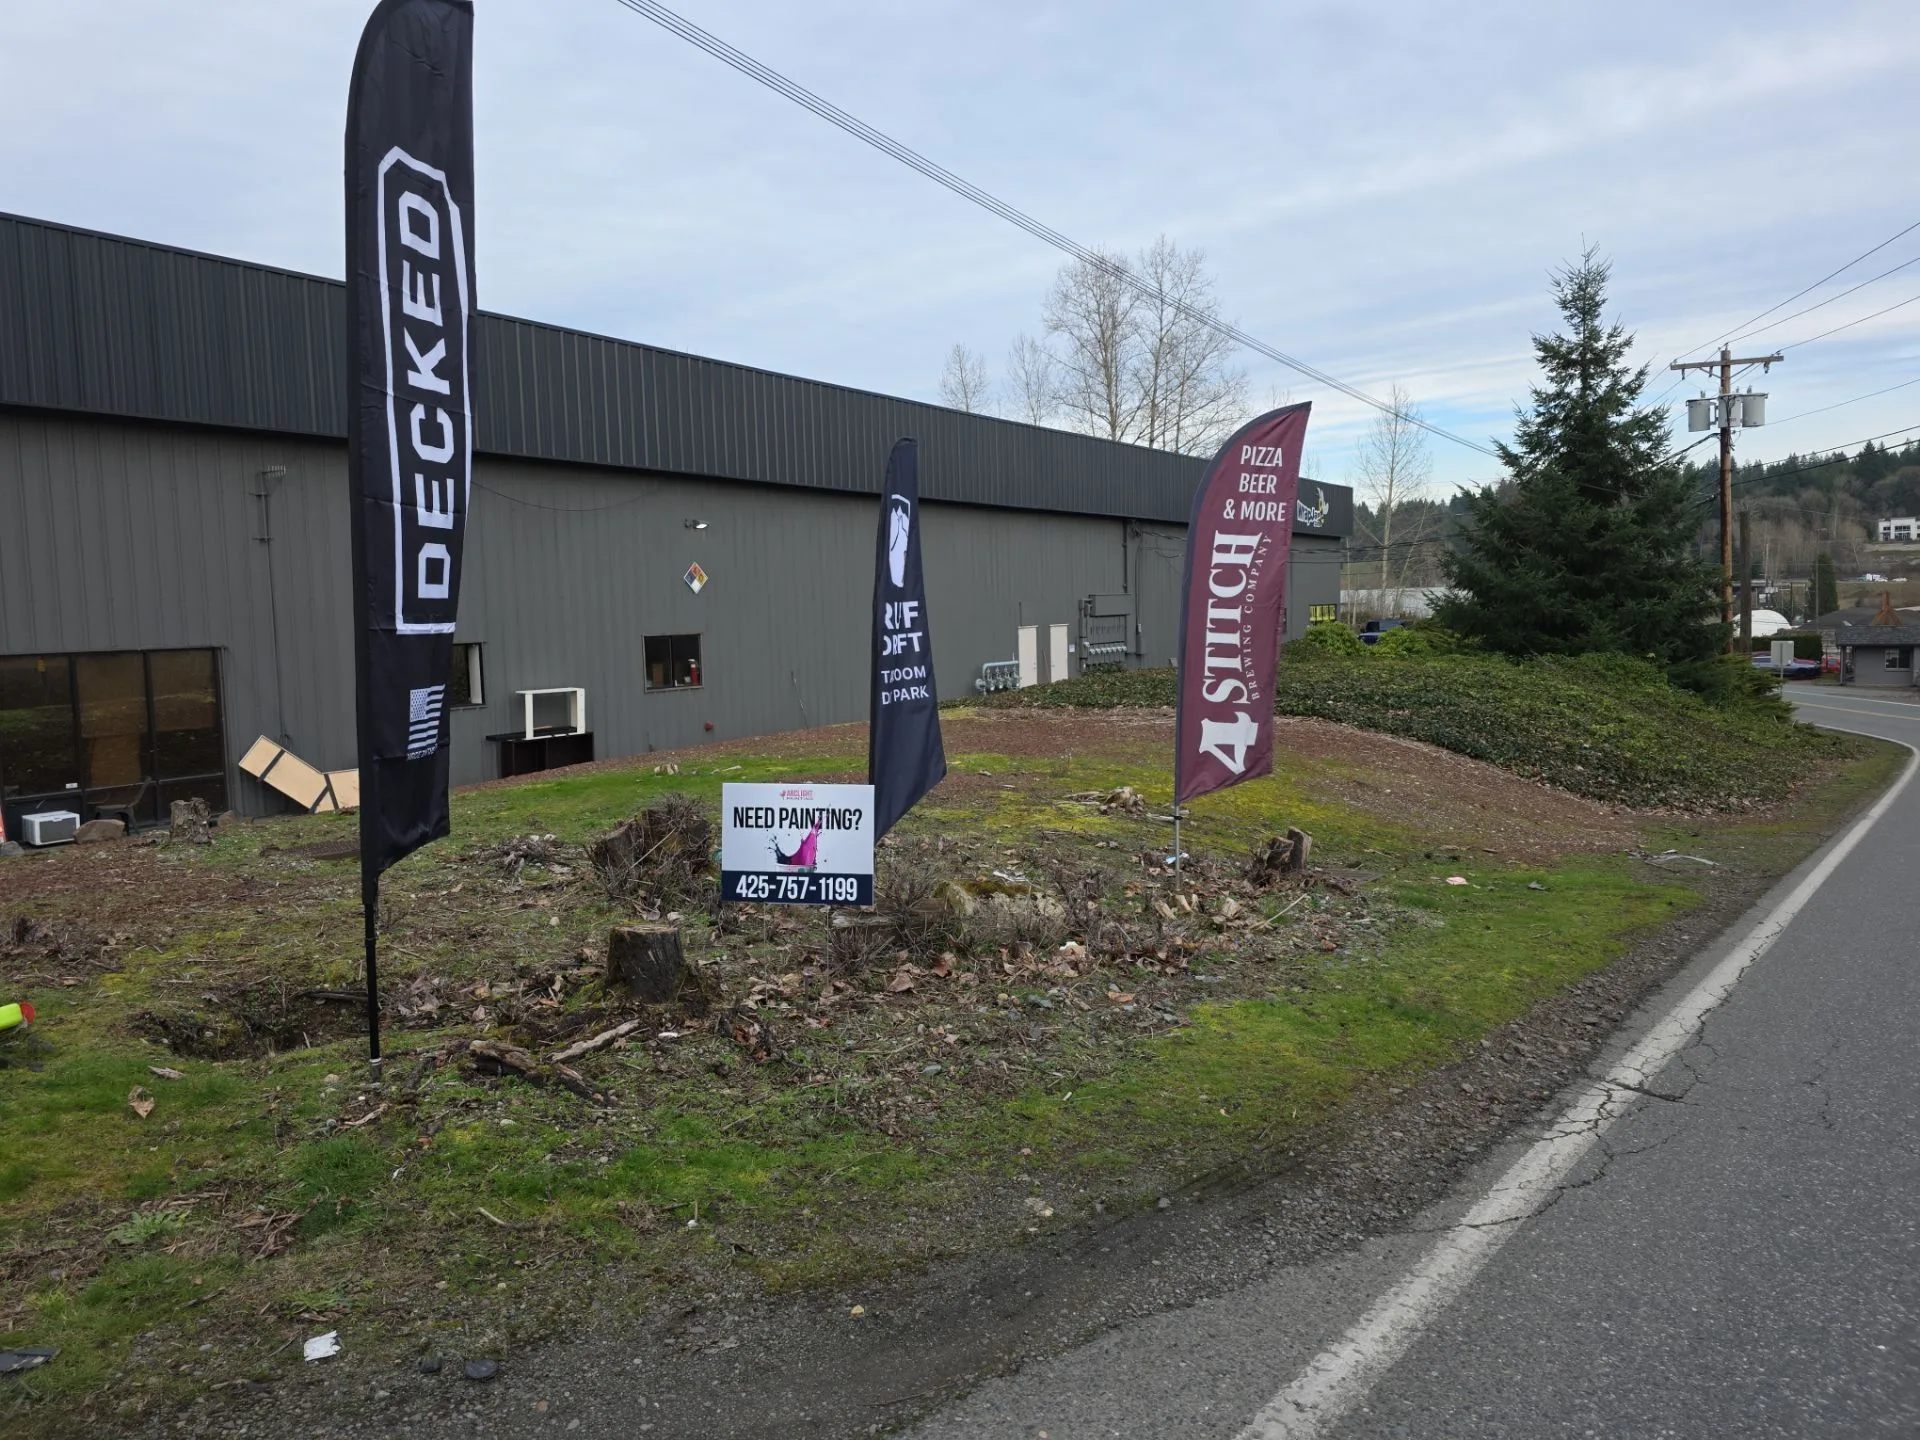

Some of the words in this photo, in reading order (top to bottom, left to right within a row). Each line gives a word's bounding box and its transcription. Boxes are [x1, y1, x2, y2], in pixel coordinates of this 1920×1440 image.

[398, 190, 454, 599] DECKED
[1240, 445, 1283, 468] PIZZA
[1238, 473, 1277, 494] BEER
[1223, 498, 1235, 520] &
[1240, 500, 1287, 522] MORE
[1244, 535, 1272, 614] COMPANY
[1202, 530, 1263, 705] STITCH
[1243, 624, 1260, 700] BREWING
[1199, 711, 1259, 775] 4
[733, 806, 775, 829] NEED
[779, 807, 863, 830] PAINTING?
[736, 874, 858, 901] 425-757-1199
